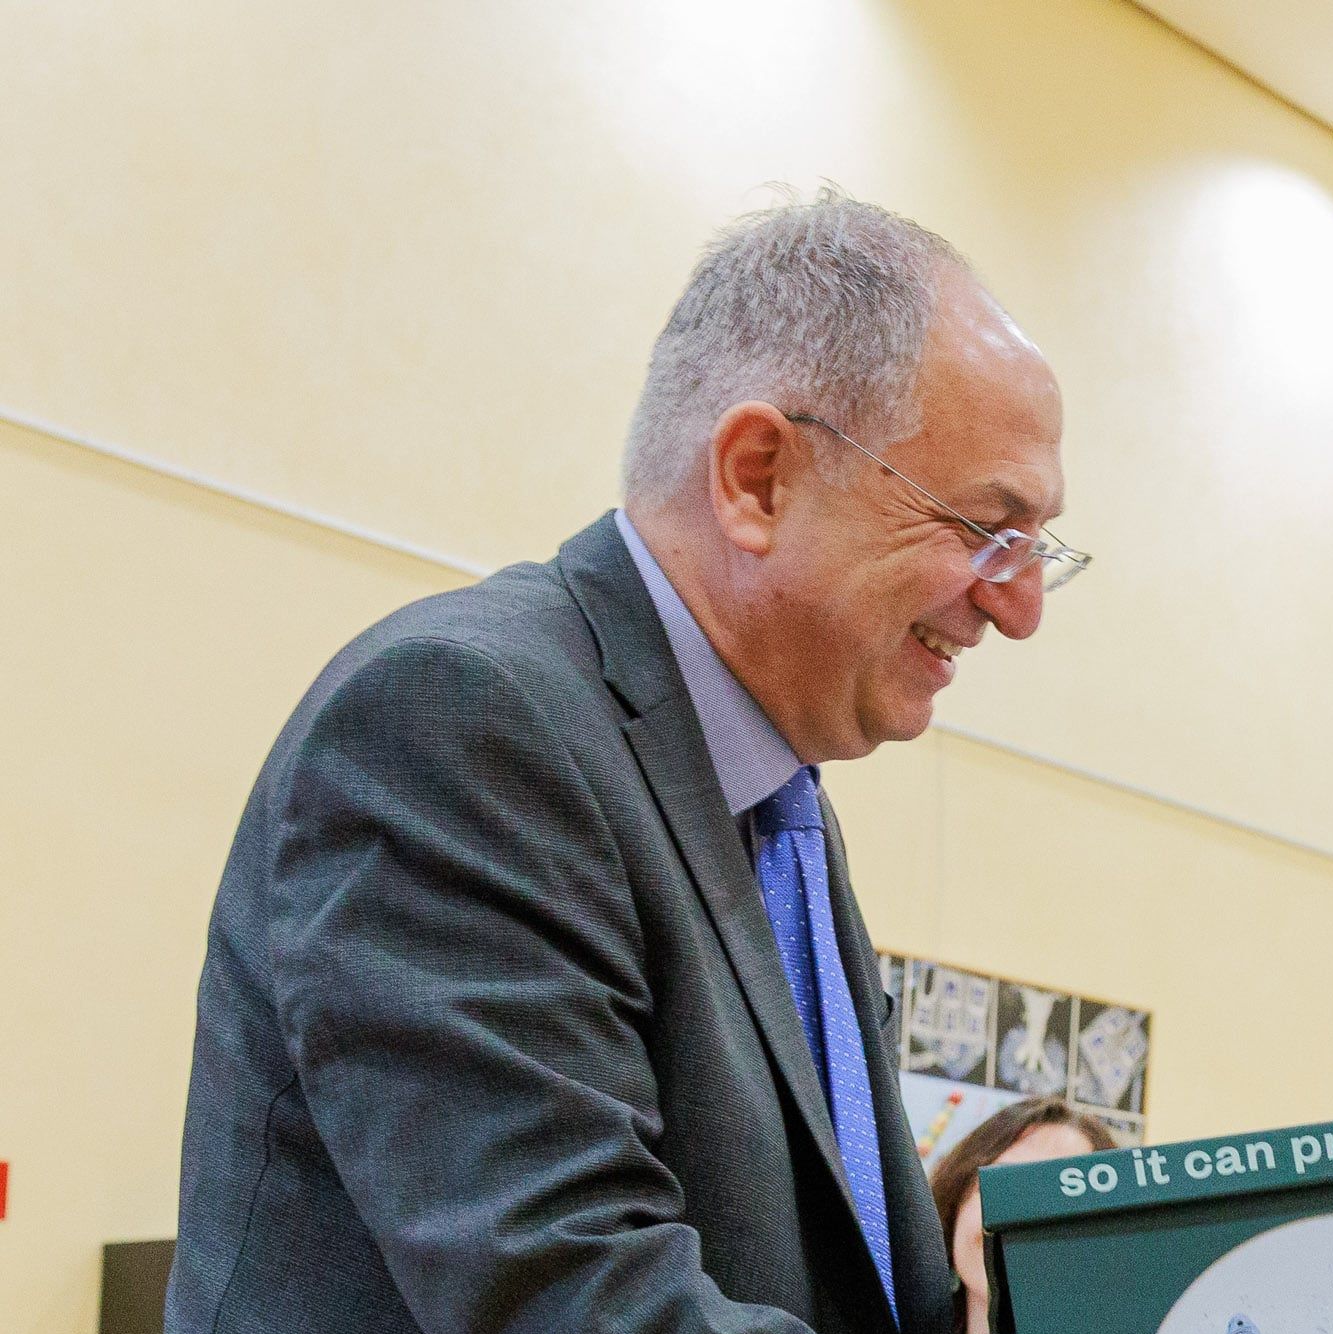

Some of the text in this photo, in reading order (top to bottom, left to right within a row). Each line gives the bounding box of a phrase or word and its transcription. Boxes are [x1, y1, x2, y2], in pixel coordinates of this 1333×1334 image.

[1058, 1161, 1119, 1198] so
[1132, 1146, 1170, 1189] it
[1184, 1138, 1277, 1182] can
